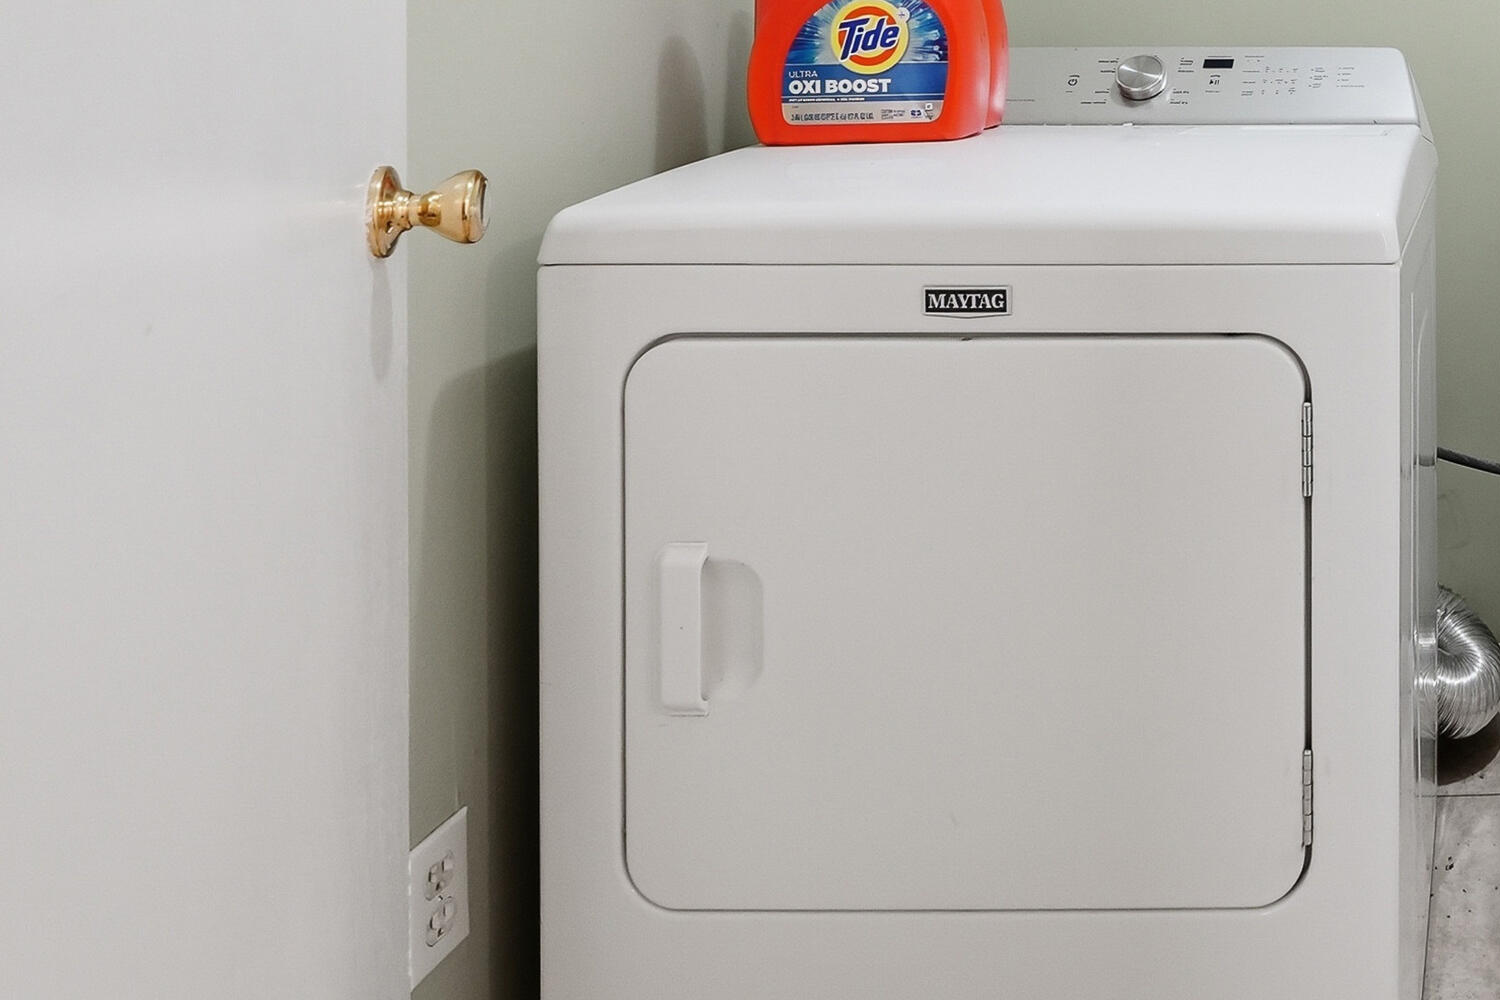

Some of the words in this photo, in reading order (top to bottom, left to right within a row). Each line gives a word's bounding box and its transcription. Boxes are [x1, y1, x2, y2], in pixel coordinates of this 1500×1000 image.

[838, 17, 900, 61] Tide
[788, 70, 818, 78] ULTRA
[788, 79, 821, 95] OXI
[825, 78, 892, 94] BOOST
[927, 293, 1005, 309] MAYTAG
